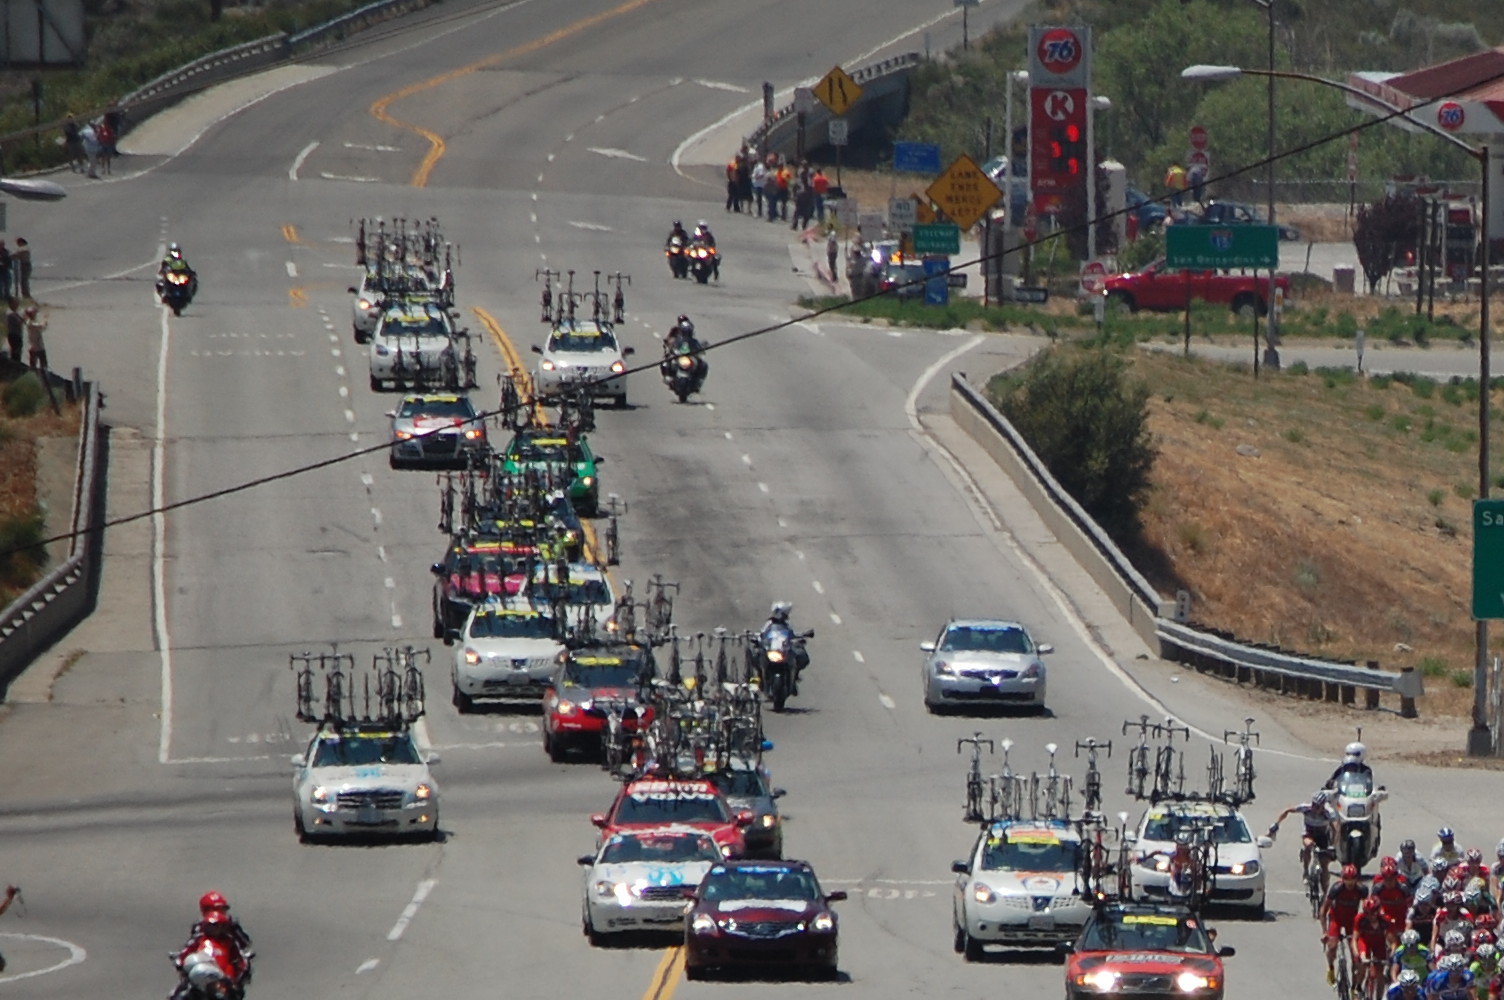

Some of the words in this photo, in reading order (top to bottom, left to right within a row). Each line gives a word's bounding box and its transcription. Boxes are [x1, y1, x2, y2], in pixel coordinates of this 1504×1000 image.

[1044, 39, 1076, 64] 76
[1050, 92, 1073, 119] K
[1441, 106, 1462, 124] 76
